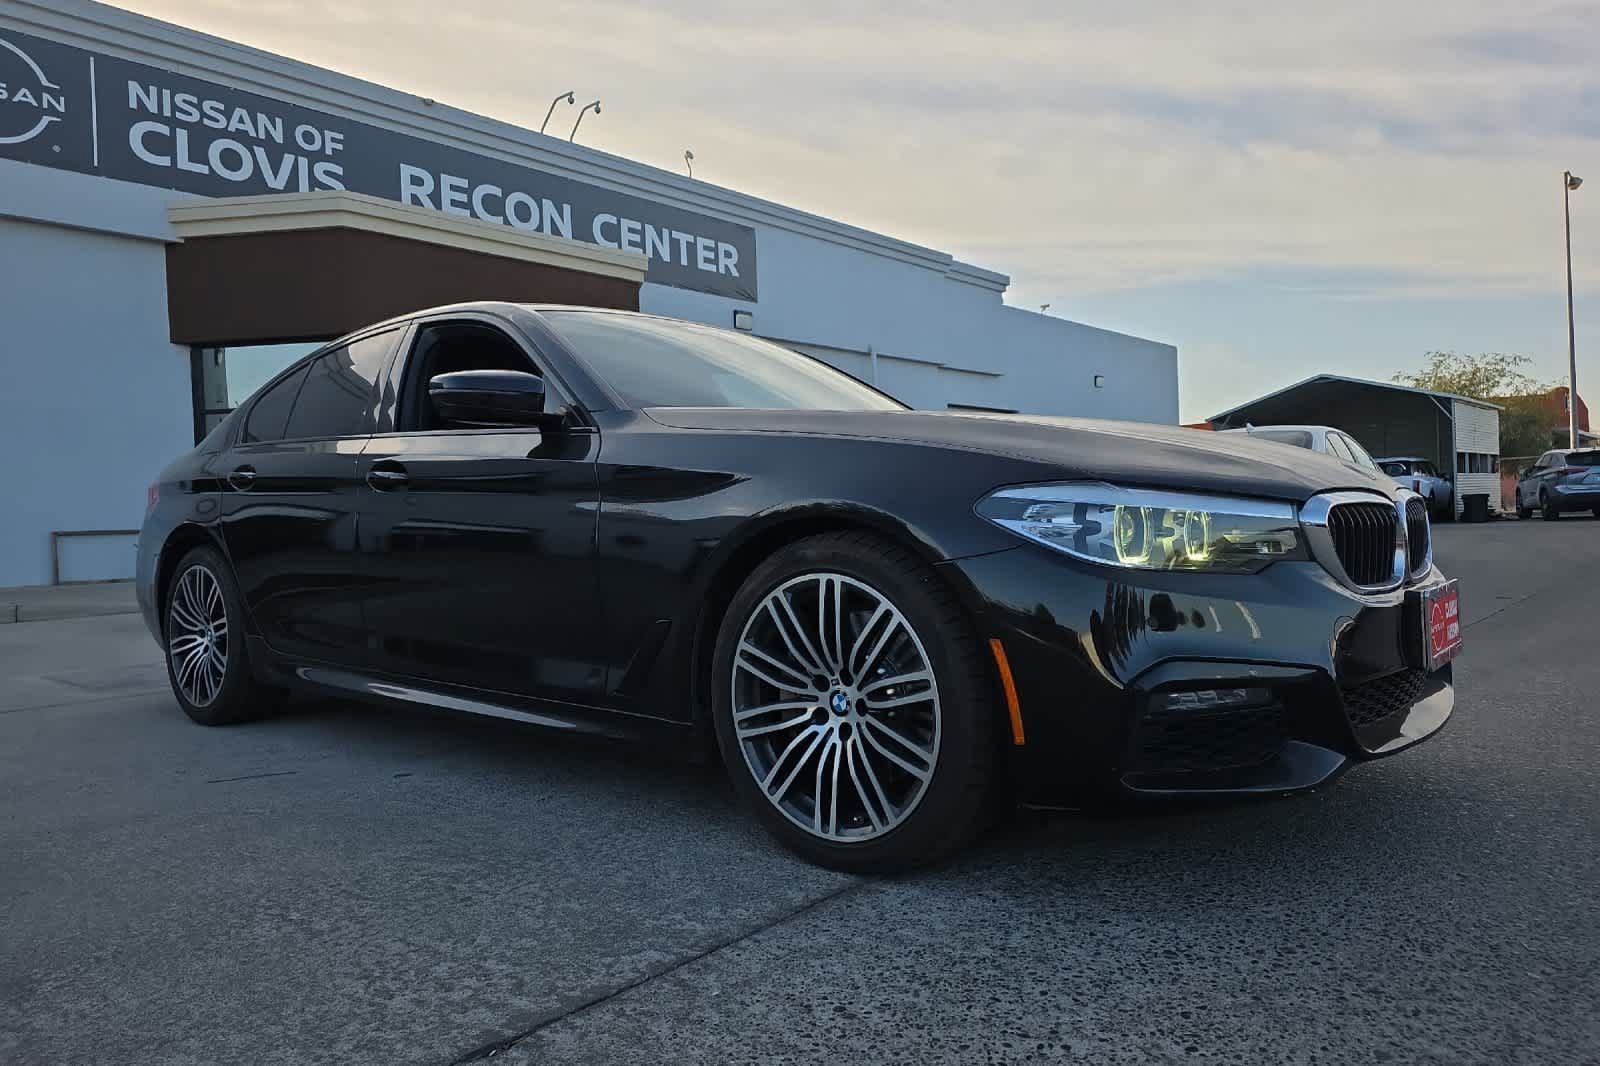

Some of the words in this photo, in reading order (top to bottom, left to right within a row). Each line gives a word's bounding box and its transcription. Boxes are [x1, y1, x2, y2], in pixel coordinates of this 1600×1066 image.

[127, 80, 284, 144] NISSAN
[295, 124, 345, 155] OF
[128, 121, 347, 192] CLOVIS
[400, 164, 573, 241] RECON
[592, 213, 740, 277] CENTER
